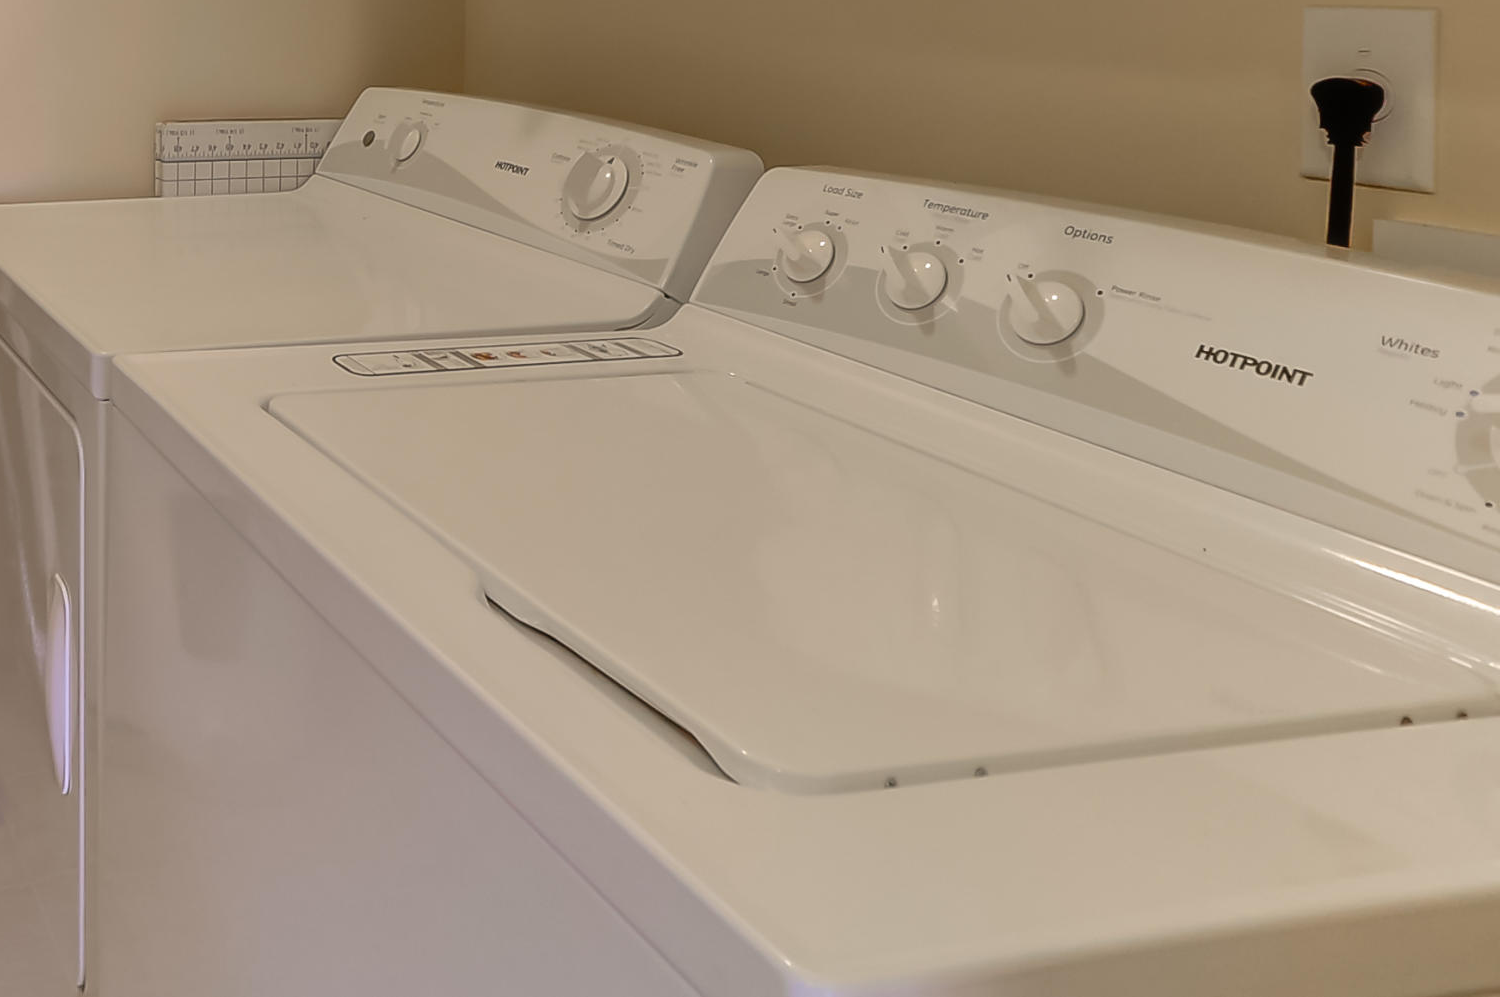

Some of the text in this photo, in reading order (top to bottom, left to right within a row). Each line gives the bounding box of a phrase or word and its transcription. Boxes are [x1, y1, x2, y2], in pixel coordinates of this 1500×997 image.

[494, 160, 530, 176] HOTPOINT
[822, 184, 864, 199] Load Size
[923, 198, 989, 221] Temperature
[1064, 225, 1114, 245] Options
[1380, 334, 1441, 359] Whites
[1195, 344, 1315, 387] HOTPOINT
